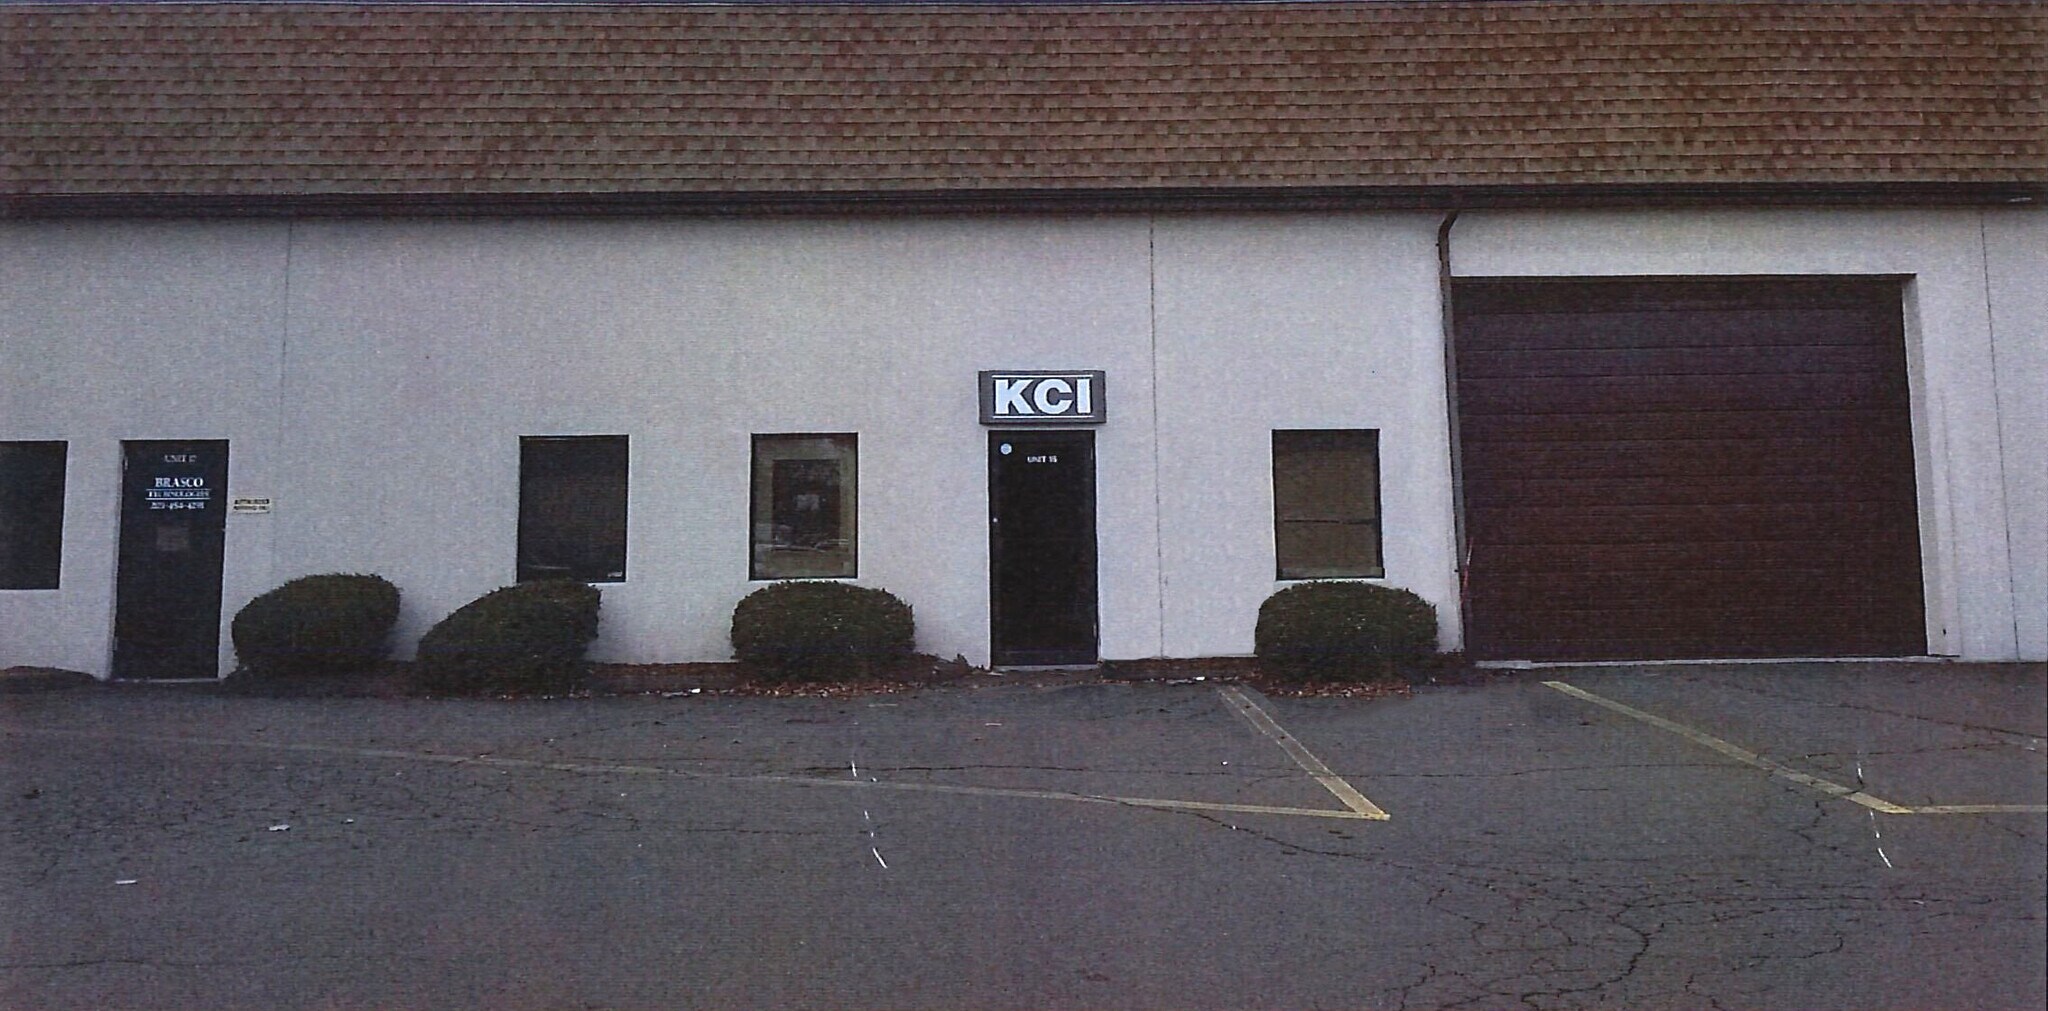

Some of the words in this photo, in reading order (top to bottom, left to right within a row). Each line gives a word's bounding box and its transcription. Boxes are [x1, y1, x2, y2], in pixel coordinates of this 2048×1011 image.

[995, 378, 1091, 414] KCI
[164, 454, 187, 463] UNIT
[1027, 455, 1046, 463] UNIT
[154, 477, 204, 488] BRASCO
